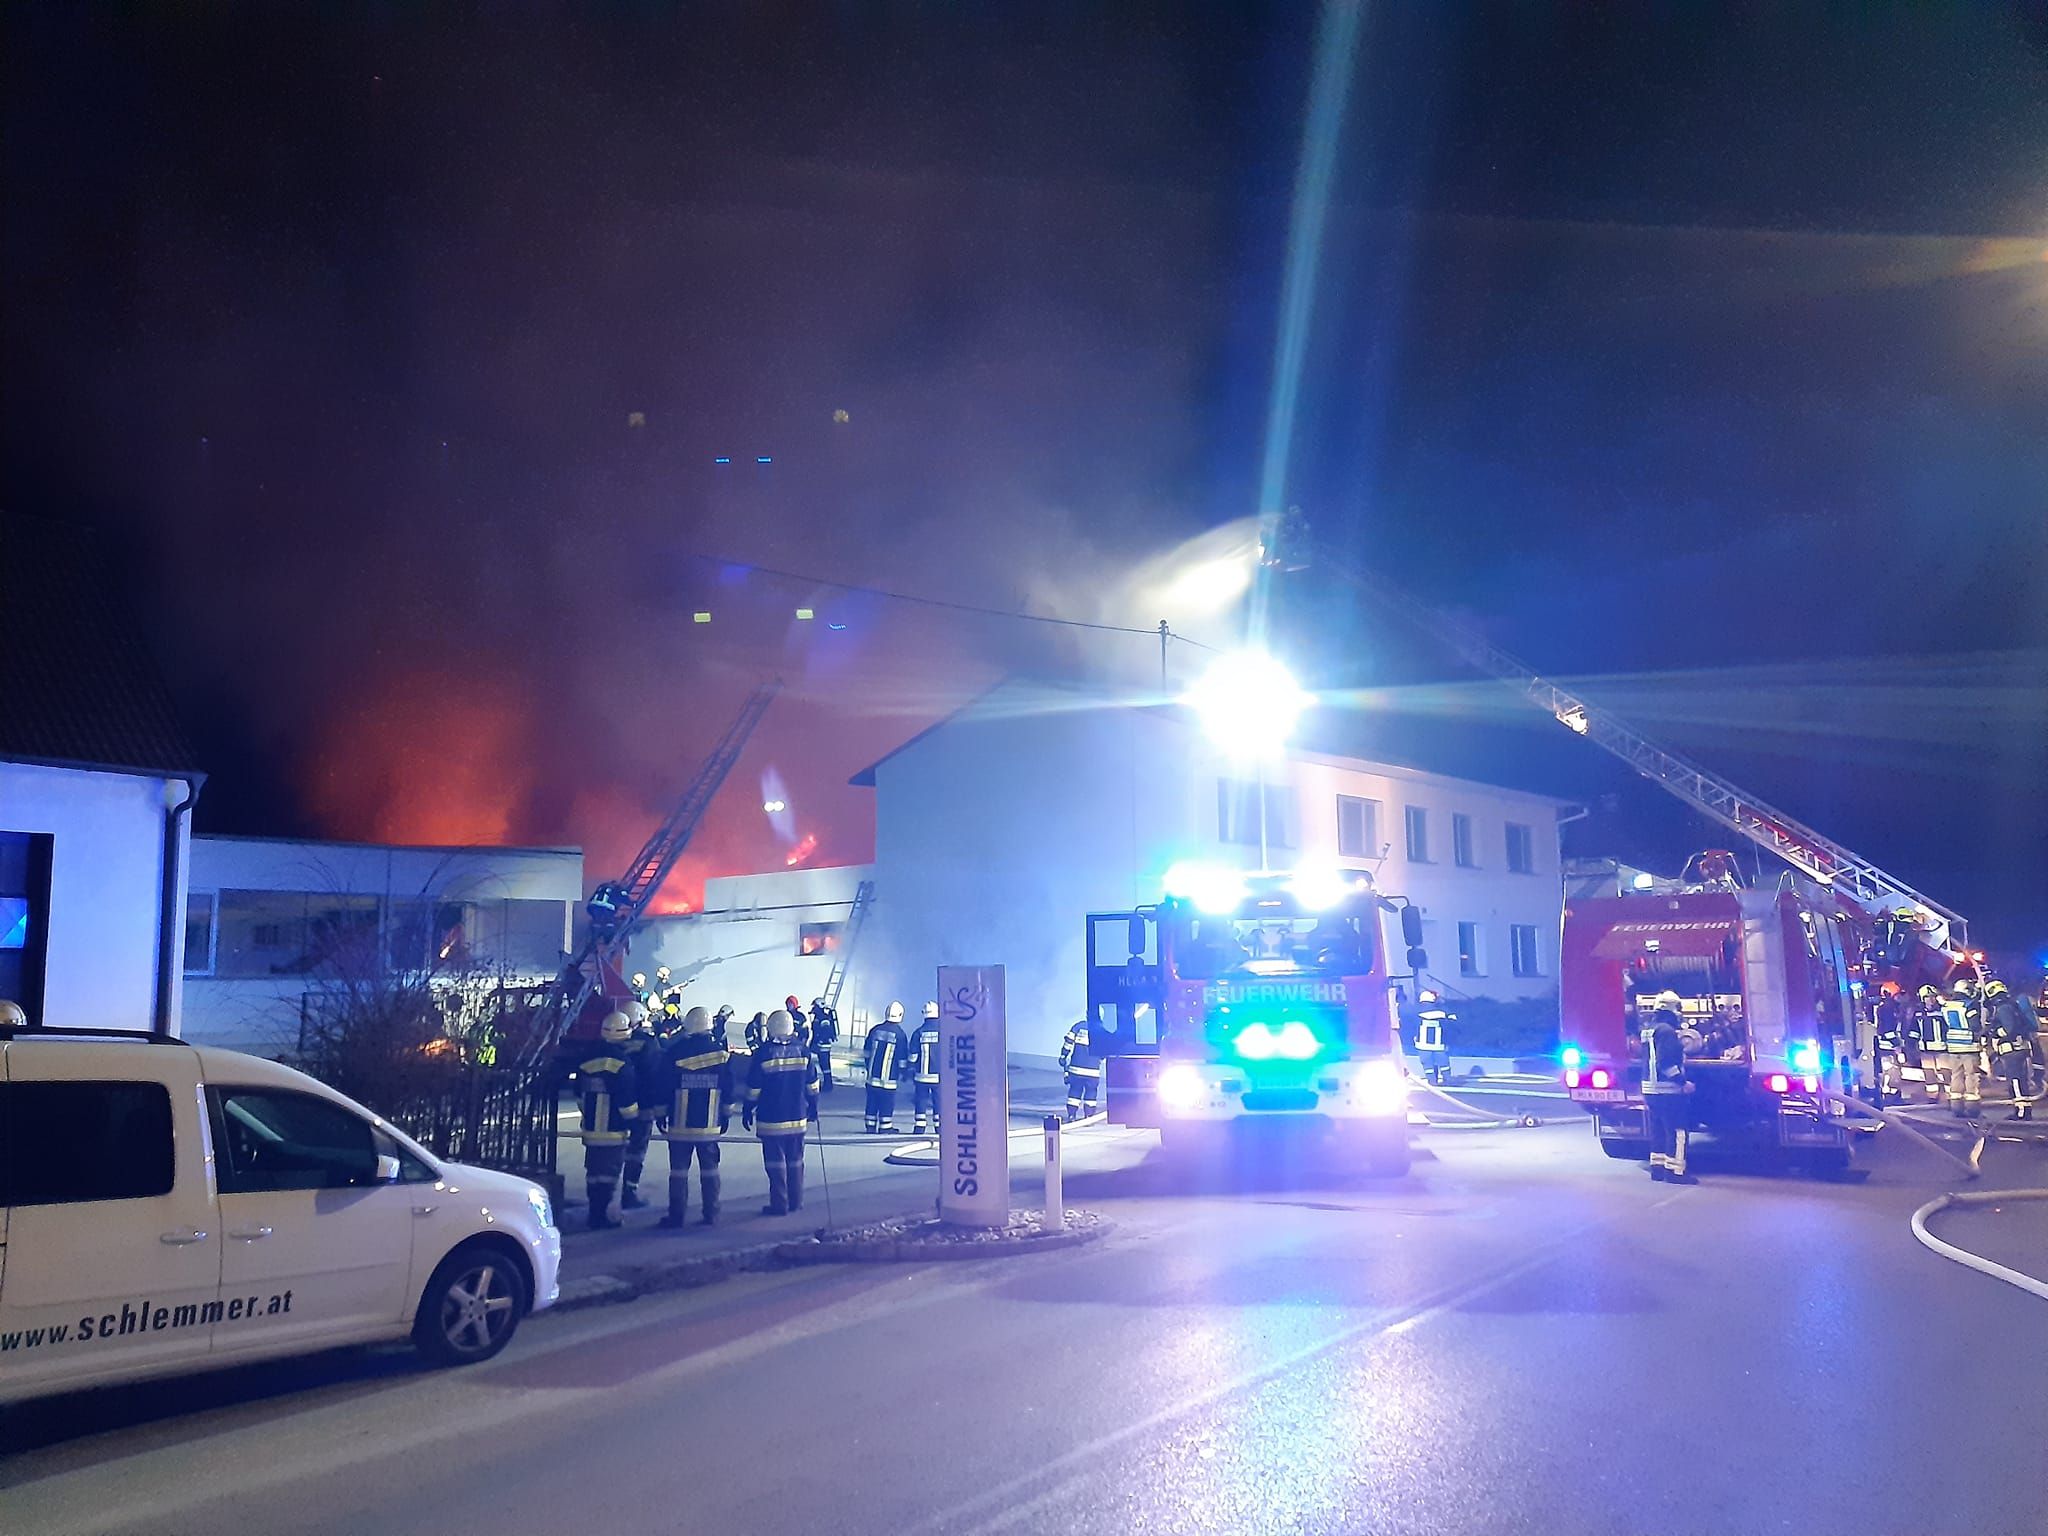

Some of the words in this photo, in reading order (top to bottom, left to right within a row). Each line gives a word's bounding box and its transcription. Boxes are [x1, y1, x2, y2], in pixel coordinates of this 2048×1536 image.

[1611, 921, 1731, 932] FEUERWEHR
[1202, 982, 1347, 1005] FEUERWEHR
[954, 1034, 979, 1197] SCHLEMMER
[1, 1289, 292, 1351] www.schlemmer.at
